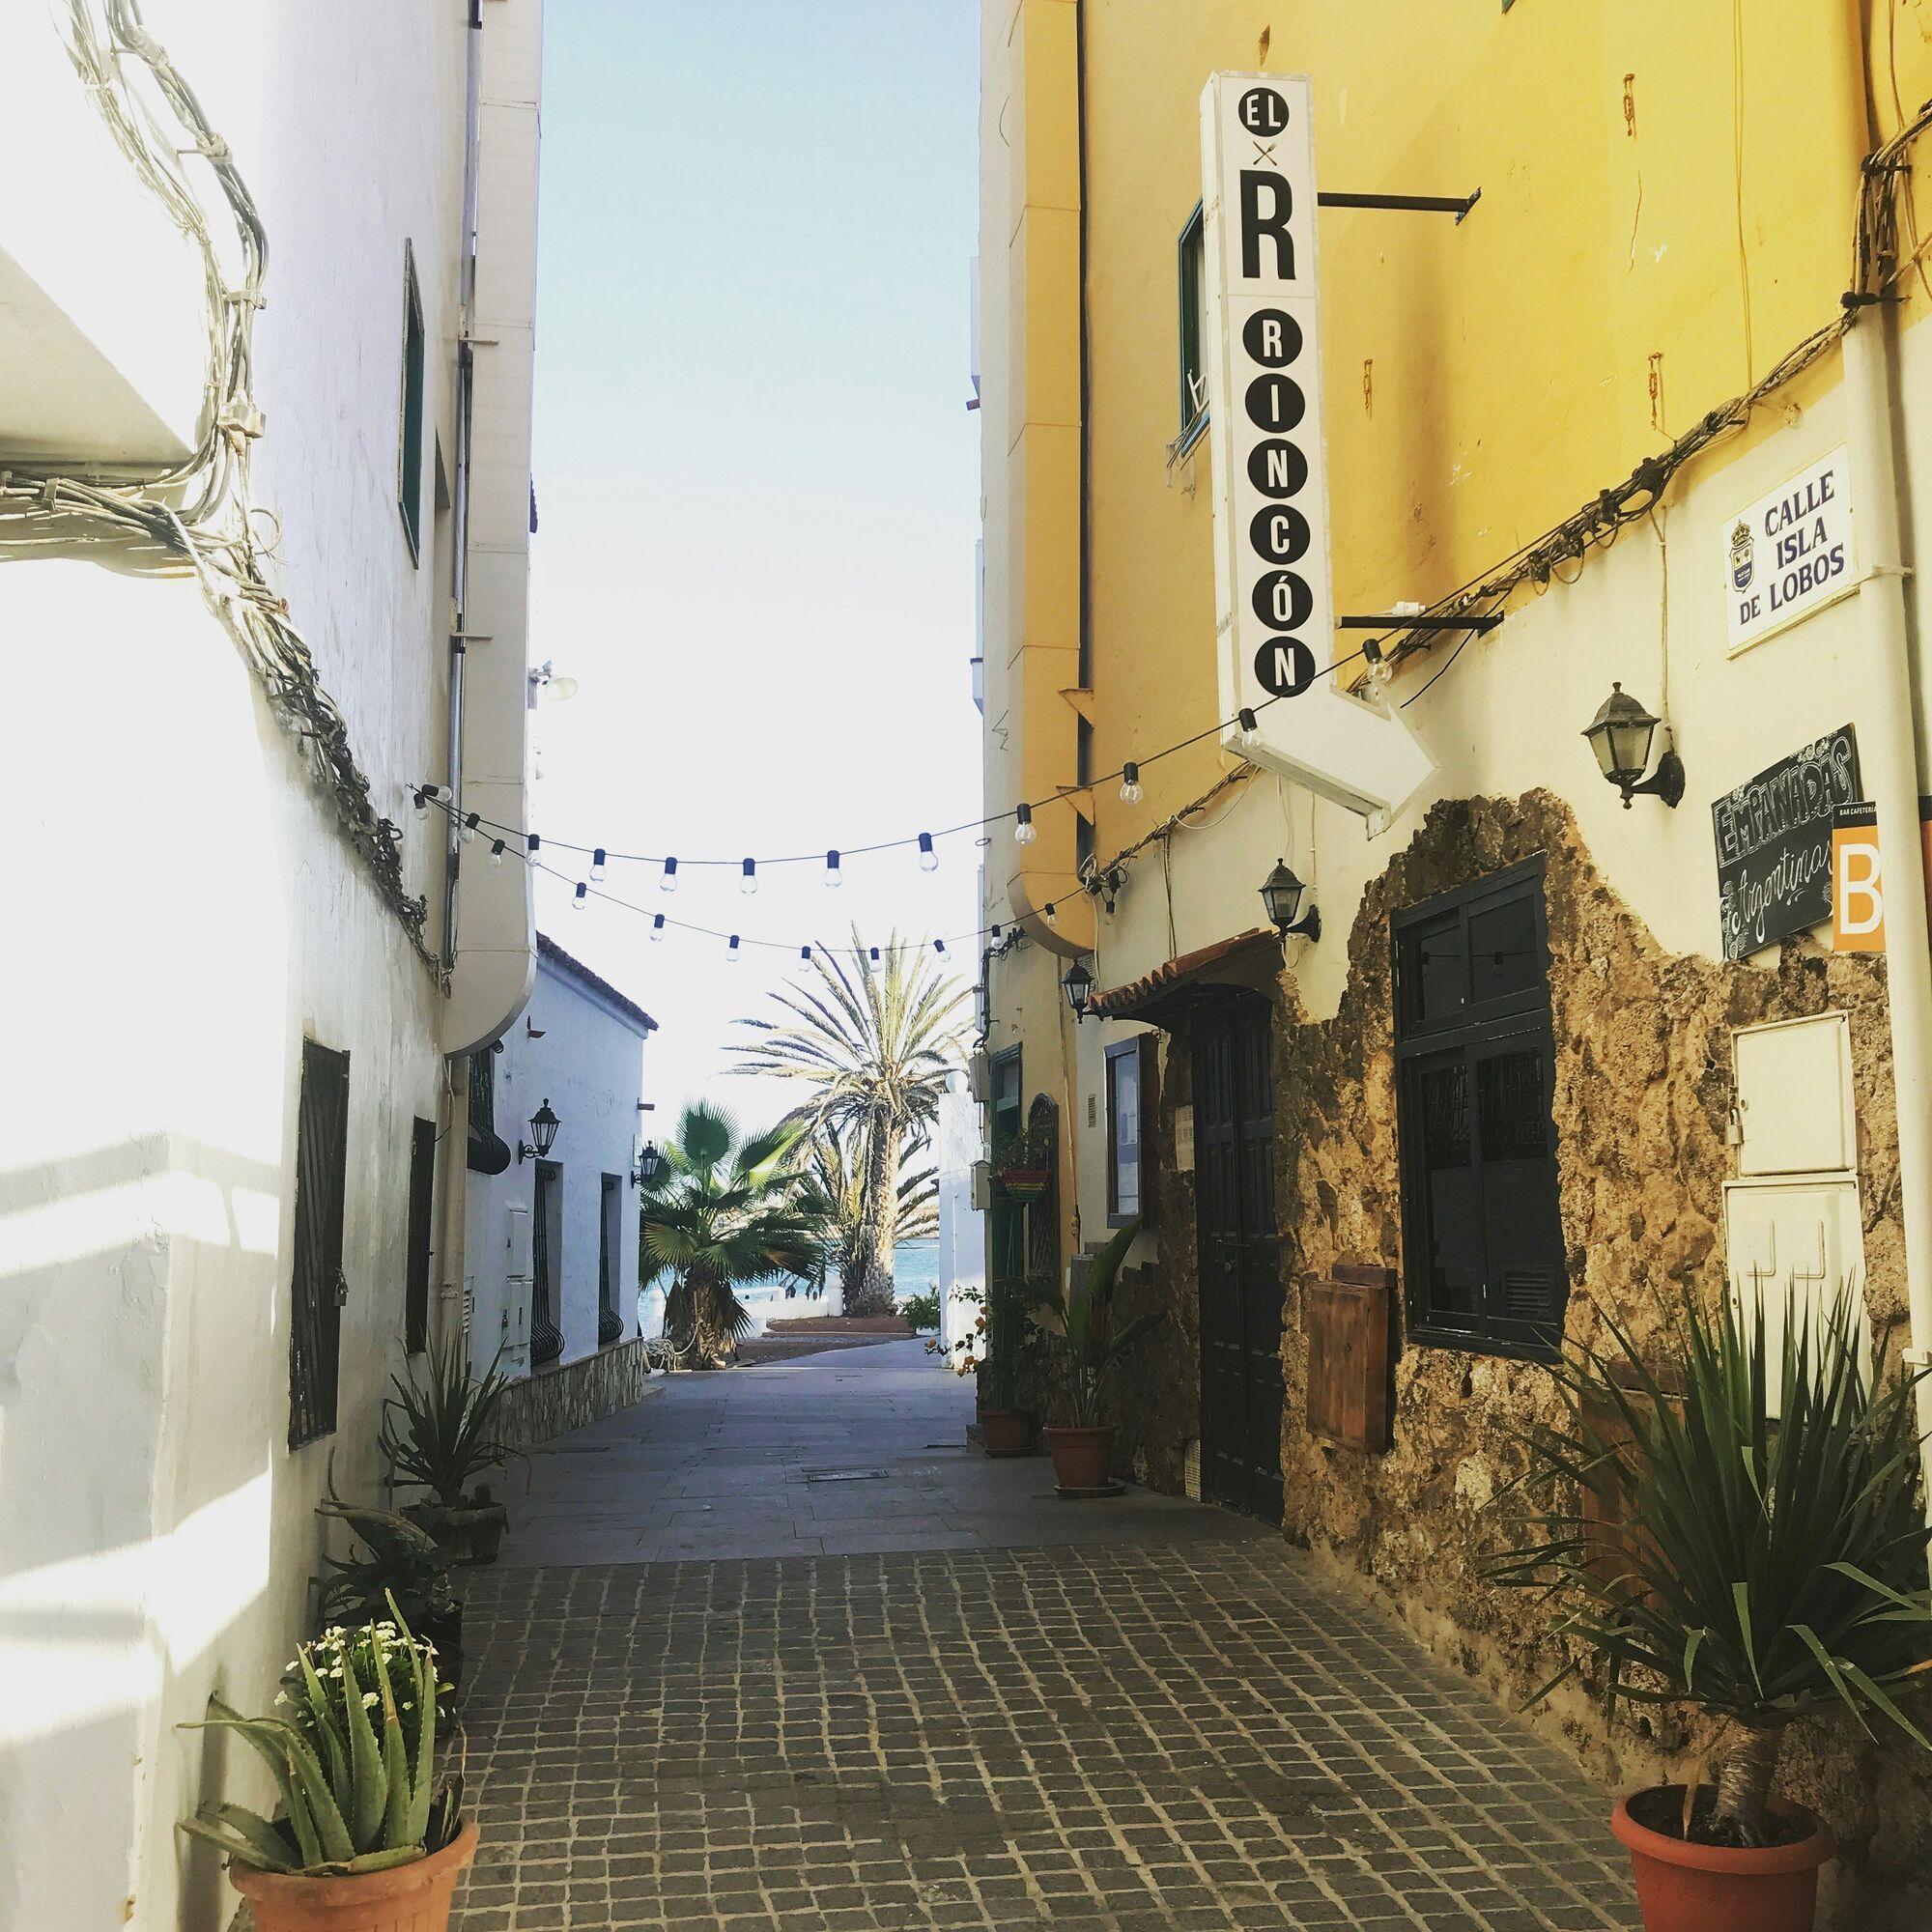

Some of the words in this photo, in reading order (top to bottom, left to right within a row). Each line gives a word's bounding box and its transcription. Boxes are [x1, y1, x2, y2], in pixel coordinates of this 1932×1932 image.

[1245, 94, 1282, 128] EL
[1239, 169, 1296, 280] R
[1764, 469, 1834, 538] CALLE
[1776, 517, 1828, 570] ISLA
[1740, 594, 1761, 626] DE
[1770, 542, 1845, 611] LOBOS
[1714, 735, 1854, 868] EMPANADAS
[1839, 808, 1850, 816] BAR
[1839, 842, 1883, 935] B
